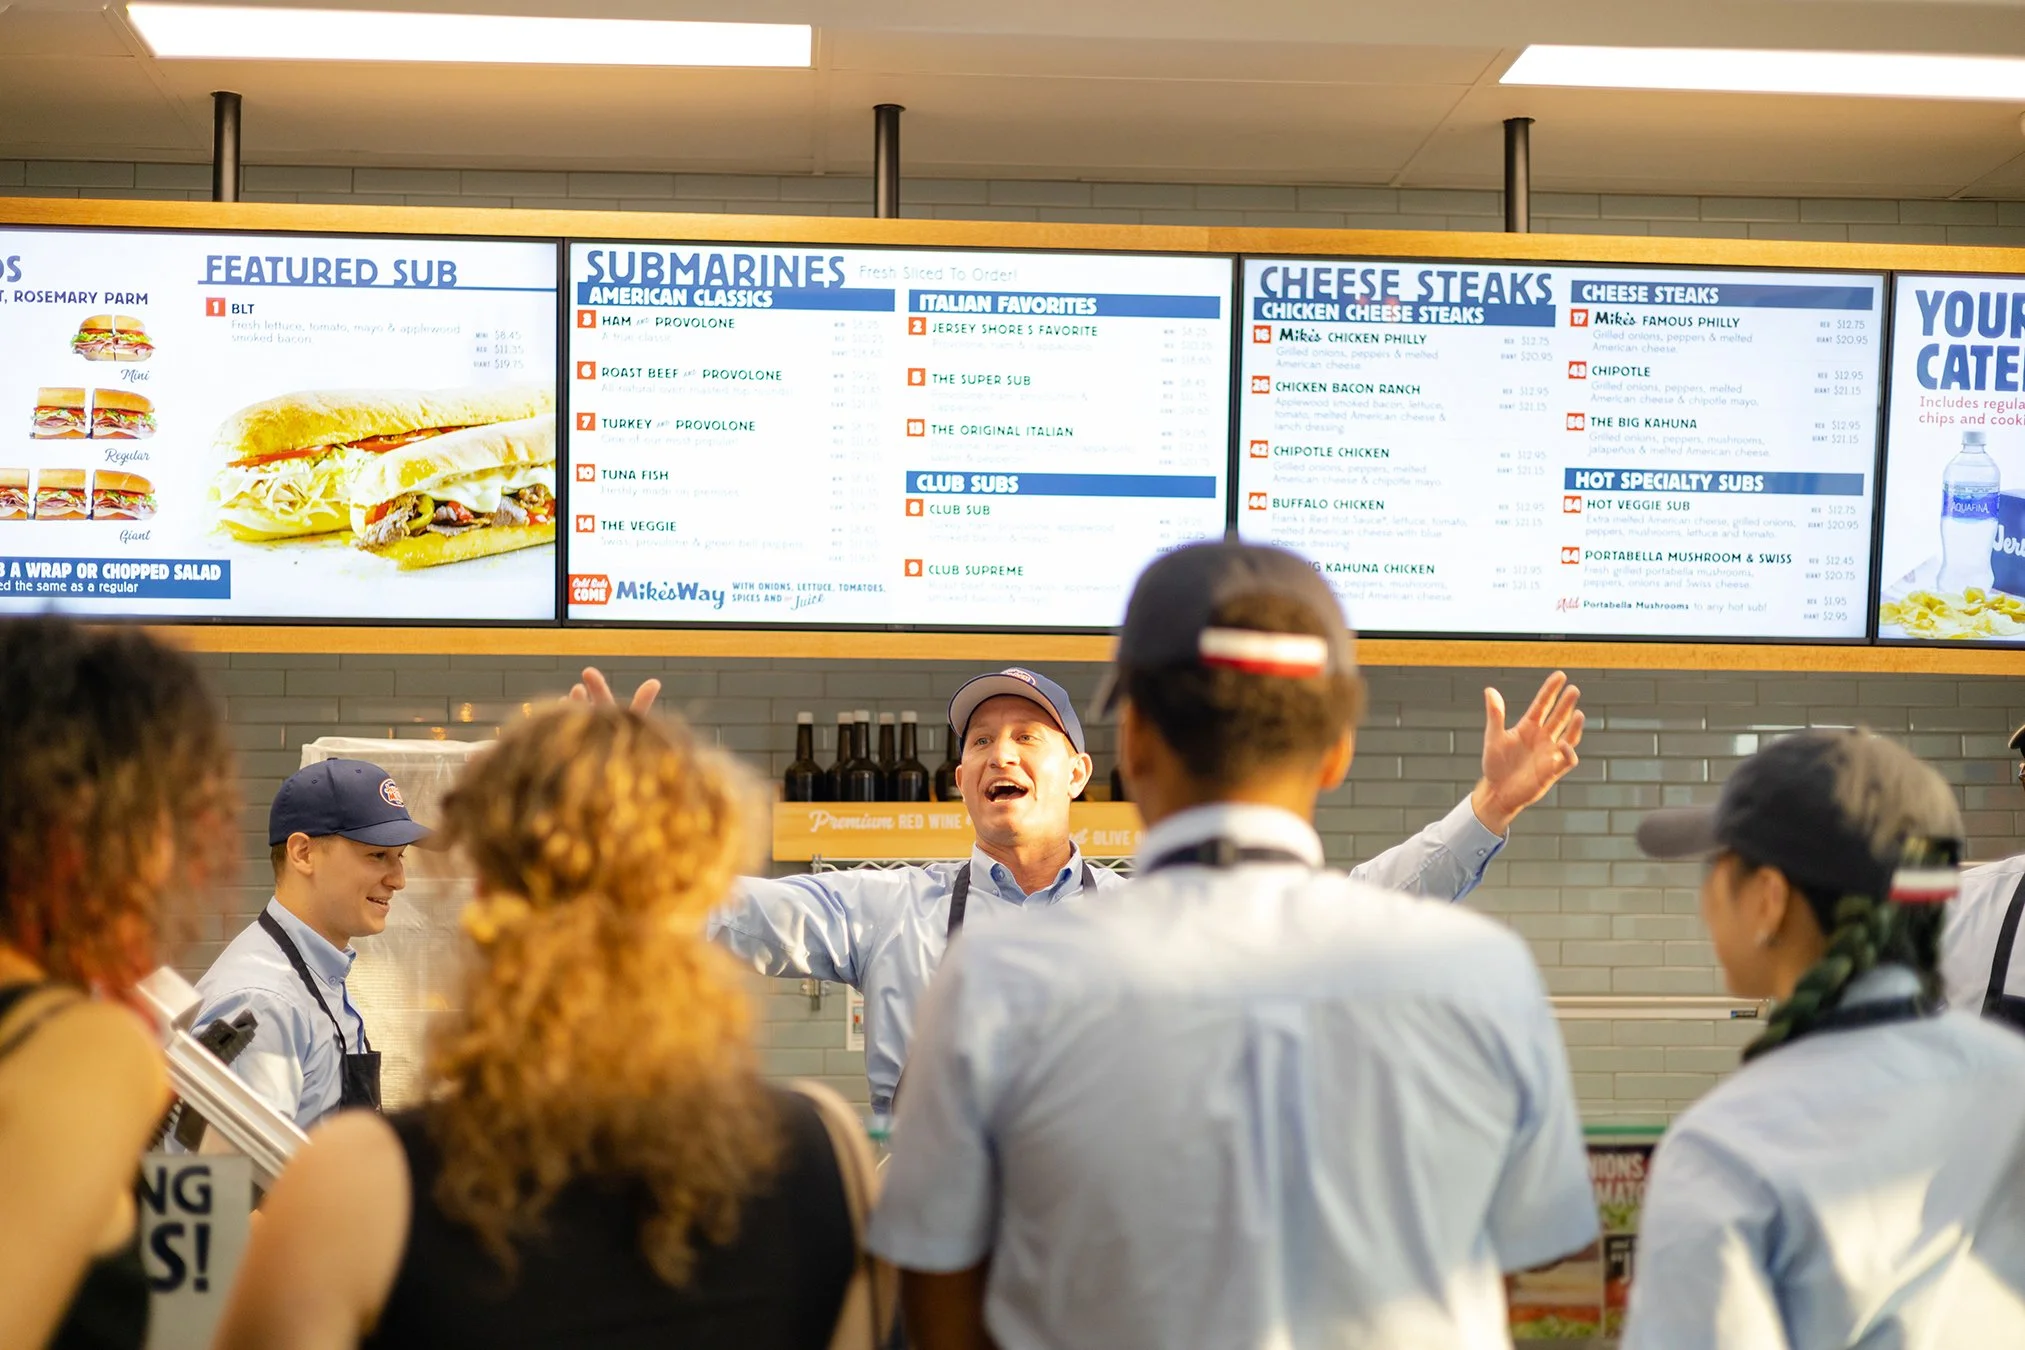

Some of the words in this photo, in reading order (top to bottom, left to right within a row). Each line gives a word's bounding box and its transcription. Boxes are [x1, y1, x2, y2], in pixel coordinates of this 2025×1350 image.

[206, 255, 378, 286] FEATURED
[394, 259, 457, 287] SUB
[587, 250, 845, 288] SUBMARINES
[859, 265, 897, 280] Fresh
[904, 267, 943, 281] Sliced
[951, 268, 966, 281] To
[972, 268, 1018, 282] Order!
[1260, 266, 1400, 301] CHEESE
[1417, 270, 1552, 304] STEAKS
[14, 290, 97, 303] ROSEMARY
[105, 291, 148, 305] PARM
[589, 287, 687, 305] AMERICAN
[694, 290, 773, 307] CLASSICS
[1582, 285, 1648, 302] CHEESE
[1655, 287, 1719, 304] STEAKS
[232, 304, 255, 315] BLT
[919, 294, 991, 312] ITALIAN
[997, 296, 1097, 314] FAVORITES
[1262, 303, 1339, 320] CHICKEN
[1346, 305, 1412, 322] CHEESE
[1419, 306, 1484, 324] STEAKS
[1595, 311, 1637, 325] Mike's
[1642, 316, 1693, 327] FAMOUS
[1698, 317, 1741, 328] PHILLY
[1915, 290, 2025, 339] YOUR
[232, 320, 260, 330] Fresh
[265, 321, 302, 332] lettuce,
[309, 322, 349, 333] tomato,
[354, 324, 383, 335] mayo
[388, 323, 395, 333] &
[400, 324, 461, 336] applewood
[602, 316, 631, 326] HAM
[656, 317, 735, 328] PROVOLONE
[1837, 319, 1865, 330] $12.75
[932, 323, 976, 334] JERSEY
[1039, 325, 1098, 336] FAVORITE
[232, 333, 273, 343] smoked
[1279, 328, 1322, 342] Mike's
[1328, 332, 1379, 344] CHICKEN
[1384, 334, 1427, 345] PHILLY
[1836, 334, 1868, 346] $20.95
[602, 367, 642, 378] ROAST
[648, 368, 679, 378] BEEF
[702, 369, 783, 381] PROVOLONE
[1592, 366, 1651, 377] CHIPOTLE
[1917, 343, 2025, 392] CATE
[121, 369, 150, 383] Mini
[932, 373, 955, 384] THE
[961, 374, 1001, 385] SUPER
[1007, 376, 1032, 386] SUB
[1834, 370, 1863, 381] $12.95
[1275, 381, 1327, 392] CHICKEN
[1332, 382, 1374, 394] BACON
[1379, 384, 1420, 395] RANCH
[1834, 385, 1861, 396] $21.15
[1920, 396, 1978, 408] Includes
[602, 418, 652, 429] TURKEY
[676, 420, 756, 431] PROVOLONE
[1590, 416, 1614, 427] THE
[1618, 417, 1640, 428] BIG
[1644, 417, 1697, 429] KAHUNA
[1832, 420, 1861, 431] $12.95
[1919, 412, 1954, 427] chips
[1961, 413, 1985, 424] and
[931, 425, 955, 435] THE
[960, 425, 1020, 436] ORIGINAL
[1026, 426, 1074, 437] ITALIAN
[1831, 434, 1859, 444] $21.15
[105, 448, 150, 466] Regular
[1274, 445, 1333, 457] CHIPOTLE
[1338, 447, 1390, 458] CHICKEN
[601, 469, 636, 480] TUNA
[642, 470, 669, 480] FISH
[1576, 471, 1615, 489] HOT
[1621, 472, 1712, 490] SPECIALTY
[1719, 474, 1764, 491] SUBS
[916, 474, 965, 492] CLUB
[971, 476, 1018, 493] SUBS
[929, 504, 960, 515] CLUB
[966, 505, 991, 515] SUB
[1272, 498, 1328, 509] BUFFALO
[1333, 499, 1384, 510] CHICKEN
[1587, 499, 1613, 510] HOT
[1618, 500, 1662, 511] VEGGIE
[1667, 501, 1690, 511] SUB
[1828, 505, 1856, 515] $12.75
[1952, 502, 1989, 513] AQUAFINA
[601, 521, 625, 531] THE
[630, 521, 677, 532] VEGGIE
[1827, 520, 1859, 531] $20.95
[120, 529, 150, 544] Giant
[1585, 550, 1663, 562] PORTABELLA
[1668, 551, 1741, 563] MUSHROOM
[1746, 553, 1753, 563] &
[1759, 554, 1792, 564] SWISS
[1826, 556, 1854, 566] $12.45
[10, 562, 21, 578] A
[26, 562, 71, 579] WRAP
[77, 563, 97, 579] OR
[103, 564, 169, 580] CHOPPED
[174, 565, 221, 580] SALAD
[928, 565, 959, 575] CLUB
[965, 565, 1024, 576] SUPREME
[1326, 562, 1379, 574] KAHUNA
[1384, 564, 1435, 575] CHICKEN
[1825, 570, 1855, 581] $20.75
[15, 580, 33, 591] the
[37, 583, 67, 591] same
[71, 583, 83, 591] as
[88, 584, 94, 592] a
[99, 582, 138, 594] regular
[732, 582, 754, 590] WITH
[574, 589, 606, 601] COME
[732, 594, 760, 602] SPICES
[1583, 600, 1632, 609] Portabella
[1636, 601, 1689, 610] Mushrooms
[1694, 602, 1703, 611] to
[1707, 603, 1723, 614] any
[1728, 602, 1743, 611] hot
[1748, 603, 1767, 613] sub!
[1824, 597, 1847, 607] $1.95
[1823, 611, 1847, 621] $2.95
[809, 809, 894, 832] Premium
[898, 814, 924, 829] RED
[929, 814, 961, 829] WINE
[1093, 830, 1130, 846] OLIVE
